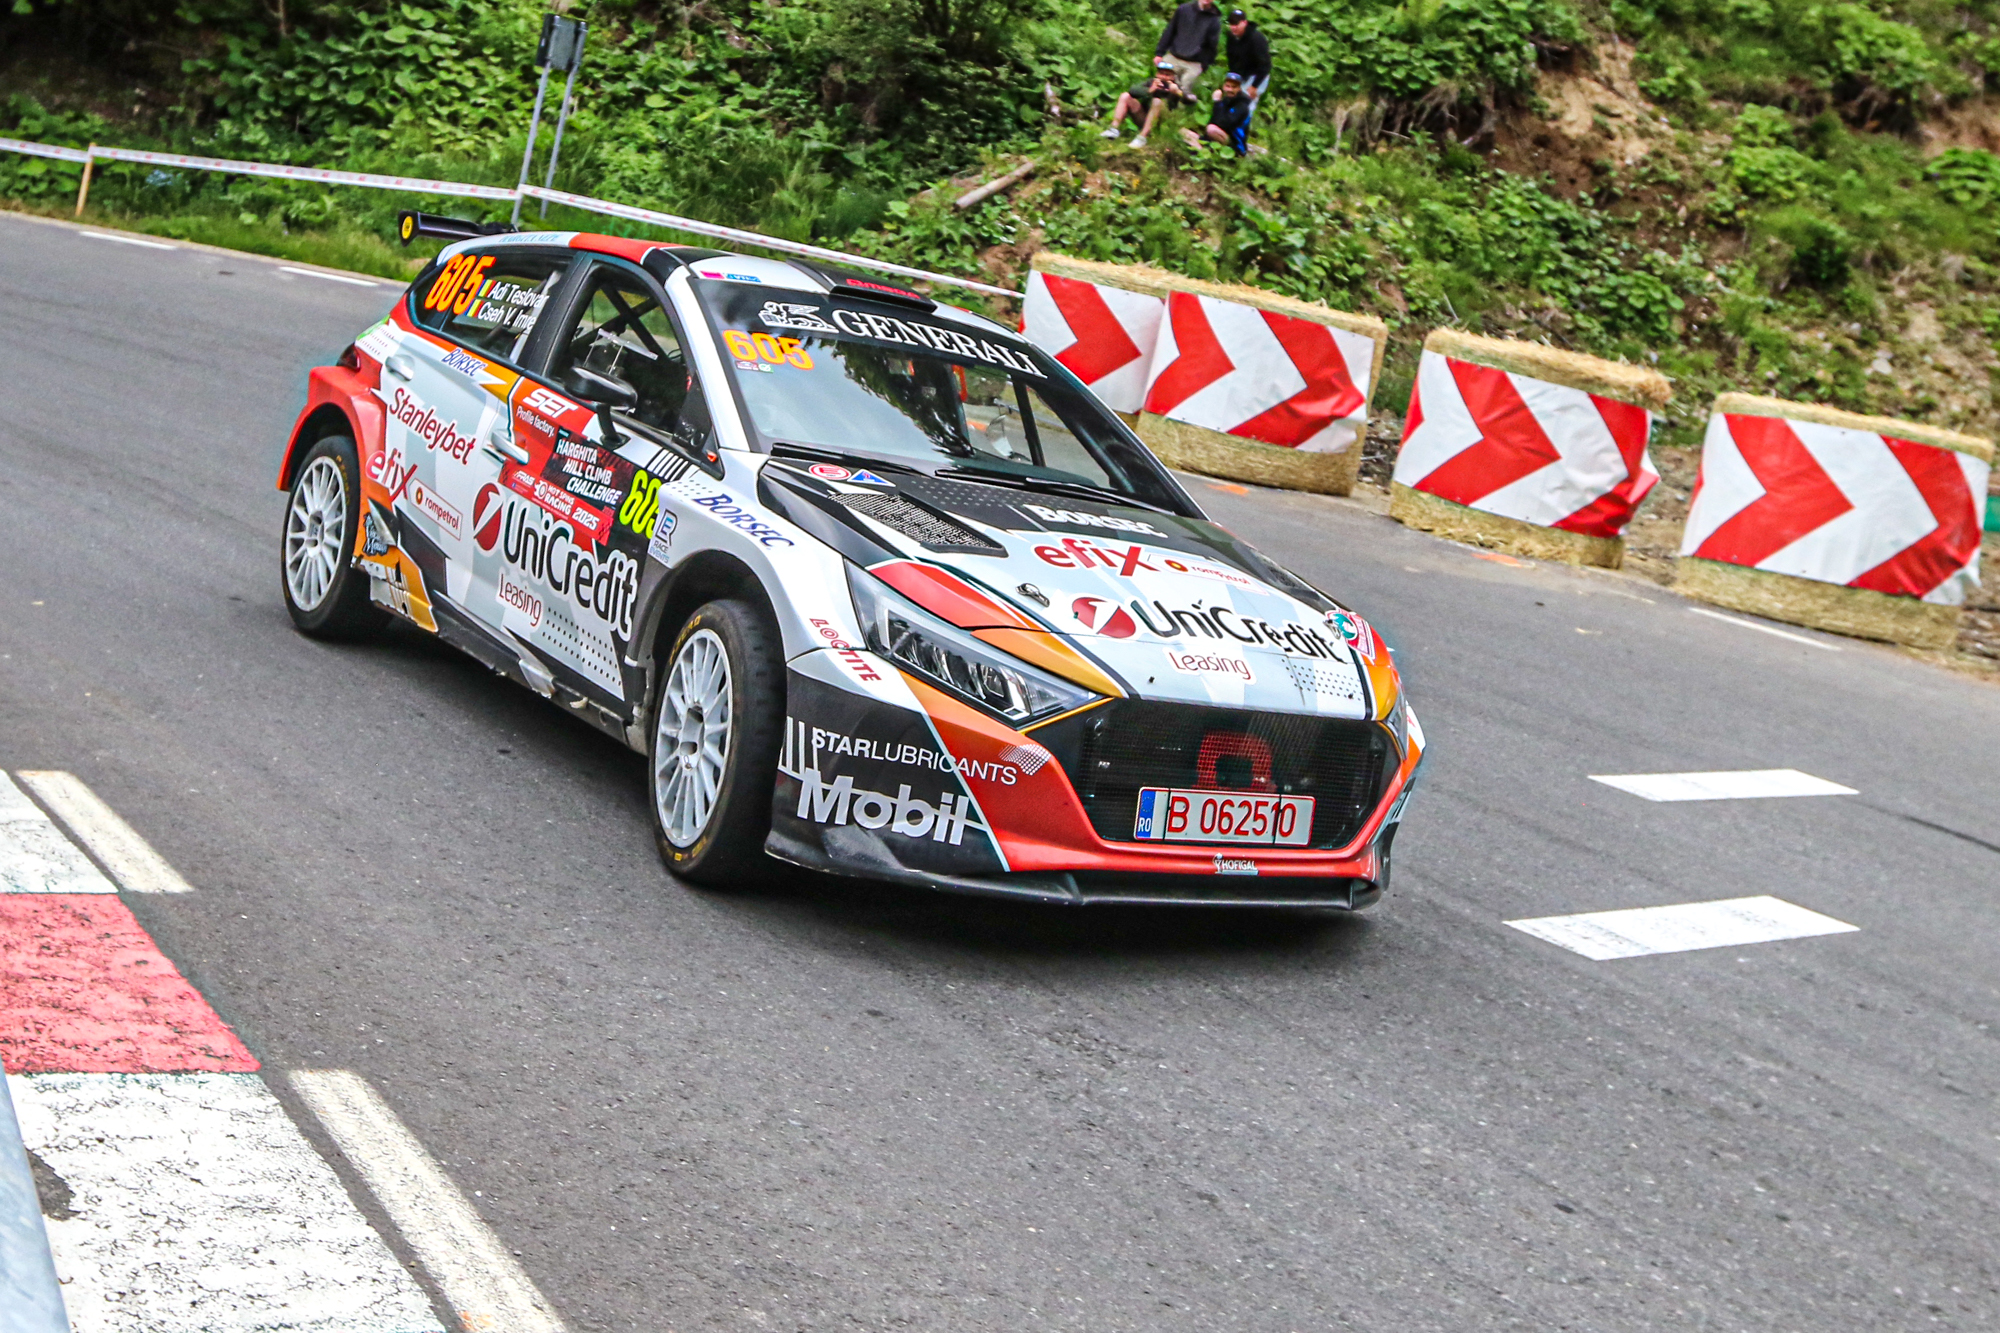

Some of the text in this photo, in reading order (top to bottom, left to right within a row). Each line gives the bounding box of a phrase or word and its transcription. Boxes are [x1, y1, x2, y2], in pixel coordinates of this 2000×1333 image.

[424, 253, 497, 315] 605
[487, 281, 511, 300] Adi
[478, 301, 537, 331] Cseh V. Imre
[722, 329, 814, 371] 605
[831, 308, 1048, 379] GENERALI
[441, 348, 488, 377] BORSEC
[515, 406, 535, 423] Profile
[522, 388, 580, 419] SET
[388, 387, 477, 466] Stanleybet
[556, 438, 599, 465] HARGITA
[366, 447, 418, 504] efix
[562, 458, 613, 485] HILL CLIMB
[544, 492, 573, 515] RACING
[566, 476, 623, 505] CHALLENGE
[424, 496, 460, 531] rompetrol
[571, 507, 600, 531] 2025
[692, 493, 795, 548] BORSEC
[1023, 503, 1169, 539] BORSEC
[649, 546, 670, 564] EVENTS
[653, 540, 669, 553] RACE
[1034, 538, 1160, 577] efix
[502, 499, 635, 635] UniCredit
[499, 572, 542, 628] Leasing
[1130, 599, 1348, 665] UniCredit
[809, 618, 881, 682] LOCTITE
[1168, 651, 1252, 680] Leasing
[797, 768, 970, 846] Mobil
[1167, 795, 1298, 838] B 062510
[1137, 817, 1152, 833] RO
[1221, 859, 1259, 871] HOFIGAL
